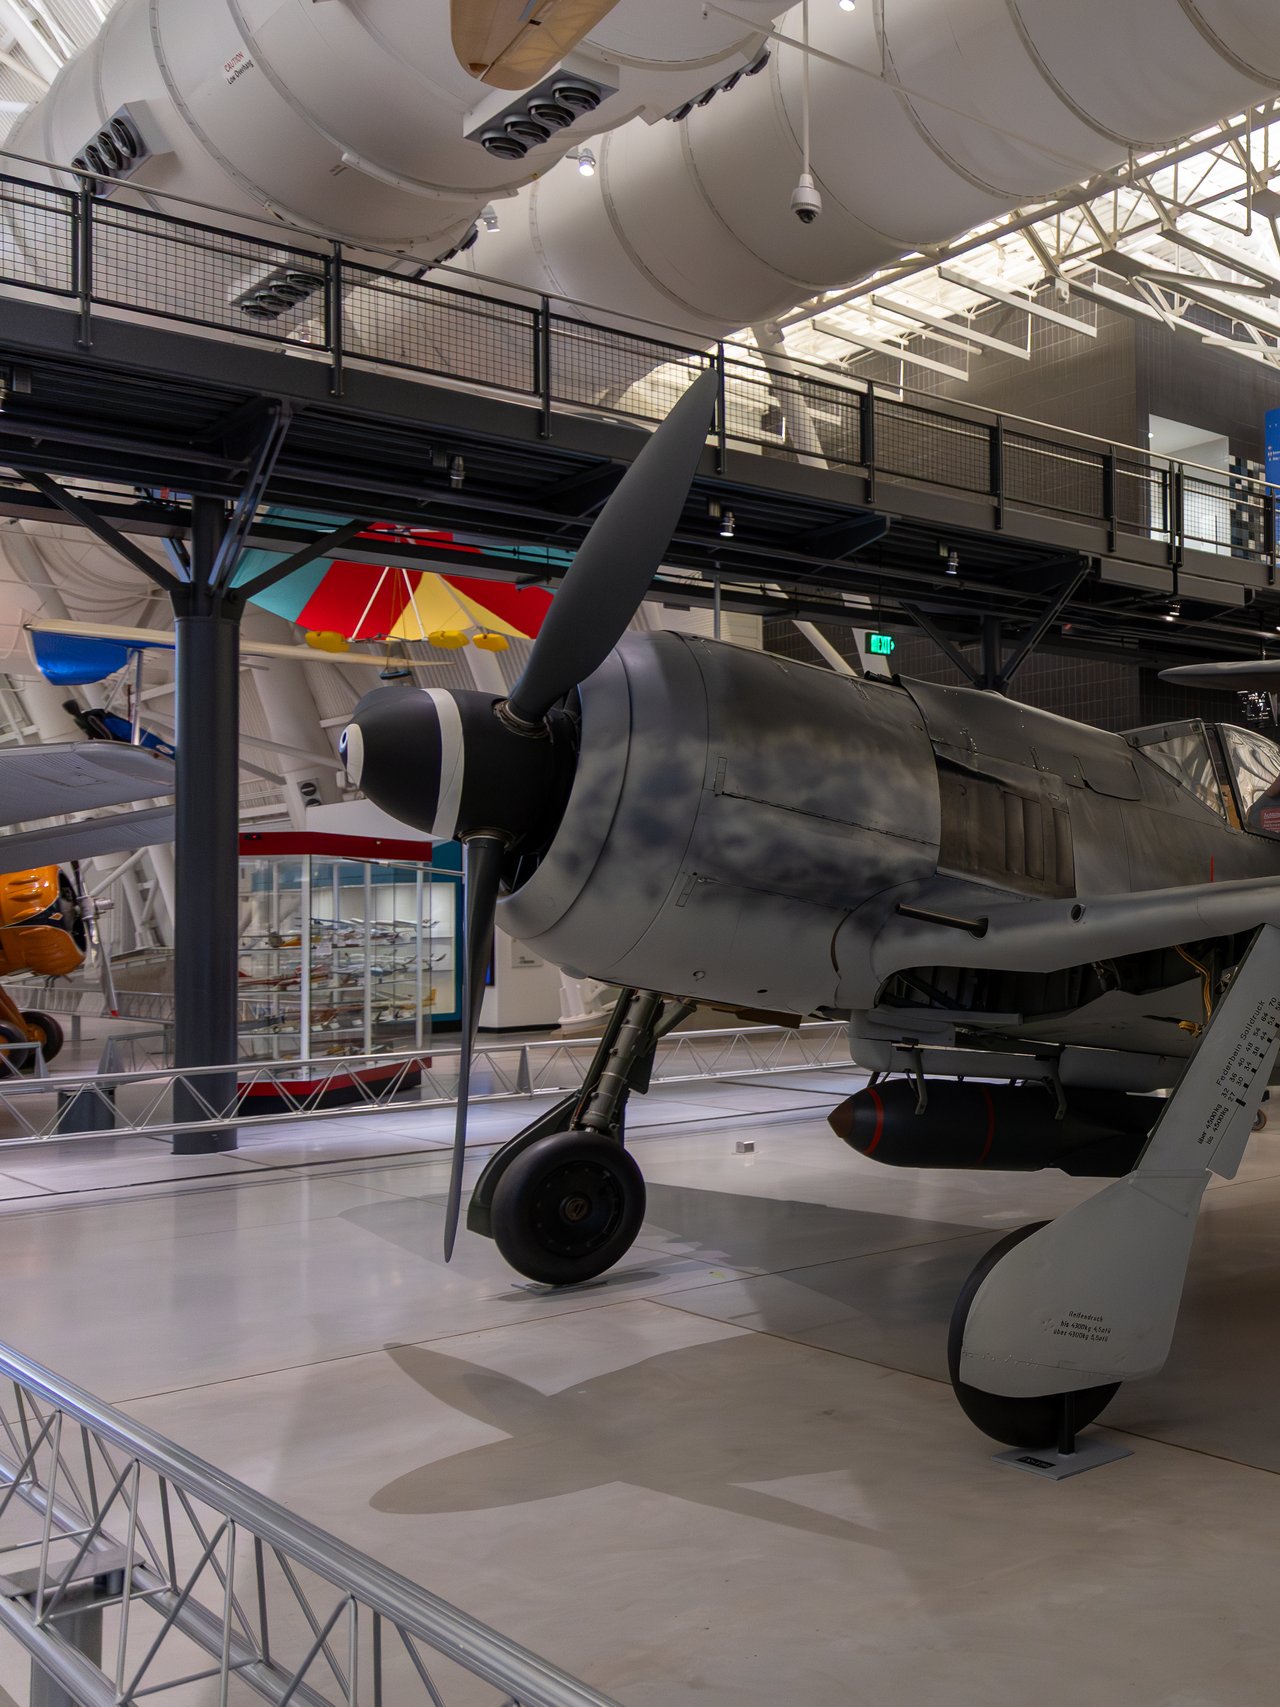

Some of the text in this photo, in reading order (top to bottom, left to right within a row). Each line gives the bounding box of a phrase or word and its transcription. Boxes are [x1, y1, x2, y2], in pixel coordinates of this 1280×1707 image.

[224, 51, 245, 73] CAUTION
[226, 59, 254, 85] Low Overhang
[1216, 1000, 1265, 1086] Federbein Solldruck
[1221, 1088, 1230, 1099] 32
[1229, 1072, 1238, 1083] 36
[1237, 1057, 1246, 1068] 40
[1252, 1027, 1262, 1037] 54
[1268, 997, 1278, 1008] 70
[1212, 1106, 1230, 1132] 4500kg
[1227, 1091, 1236, 1102] 27
[1235, 1076, 1244, 1087] 30
[1243, 1061, 1252, 1072] 34
[1251, 1046, 1260, 1057] 38
[1259, 1030, 1268, 1041] 44
[1267, 1015, 1276, 1025] 53
[1060, 1320, 1070, 1328] bis
